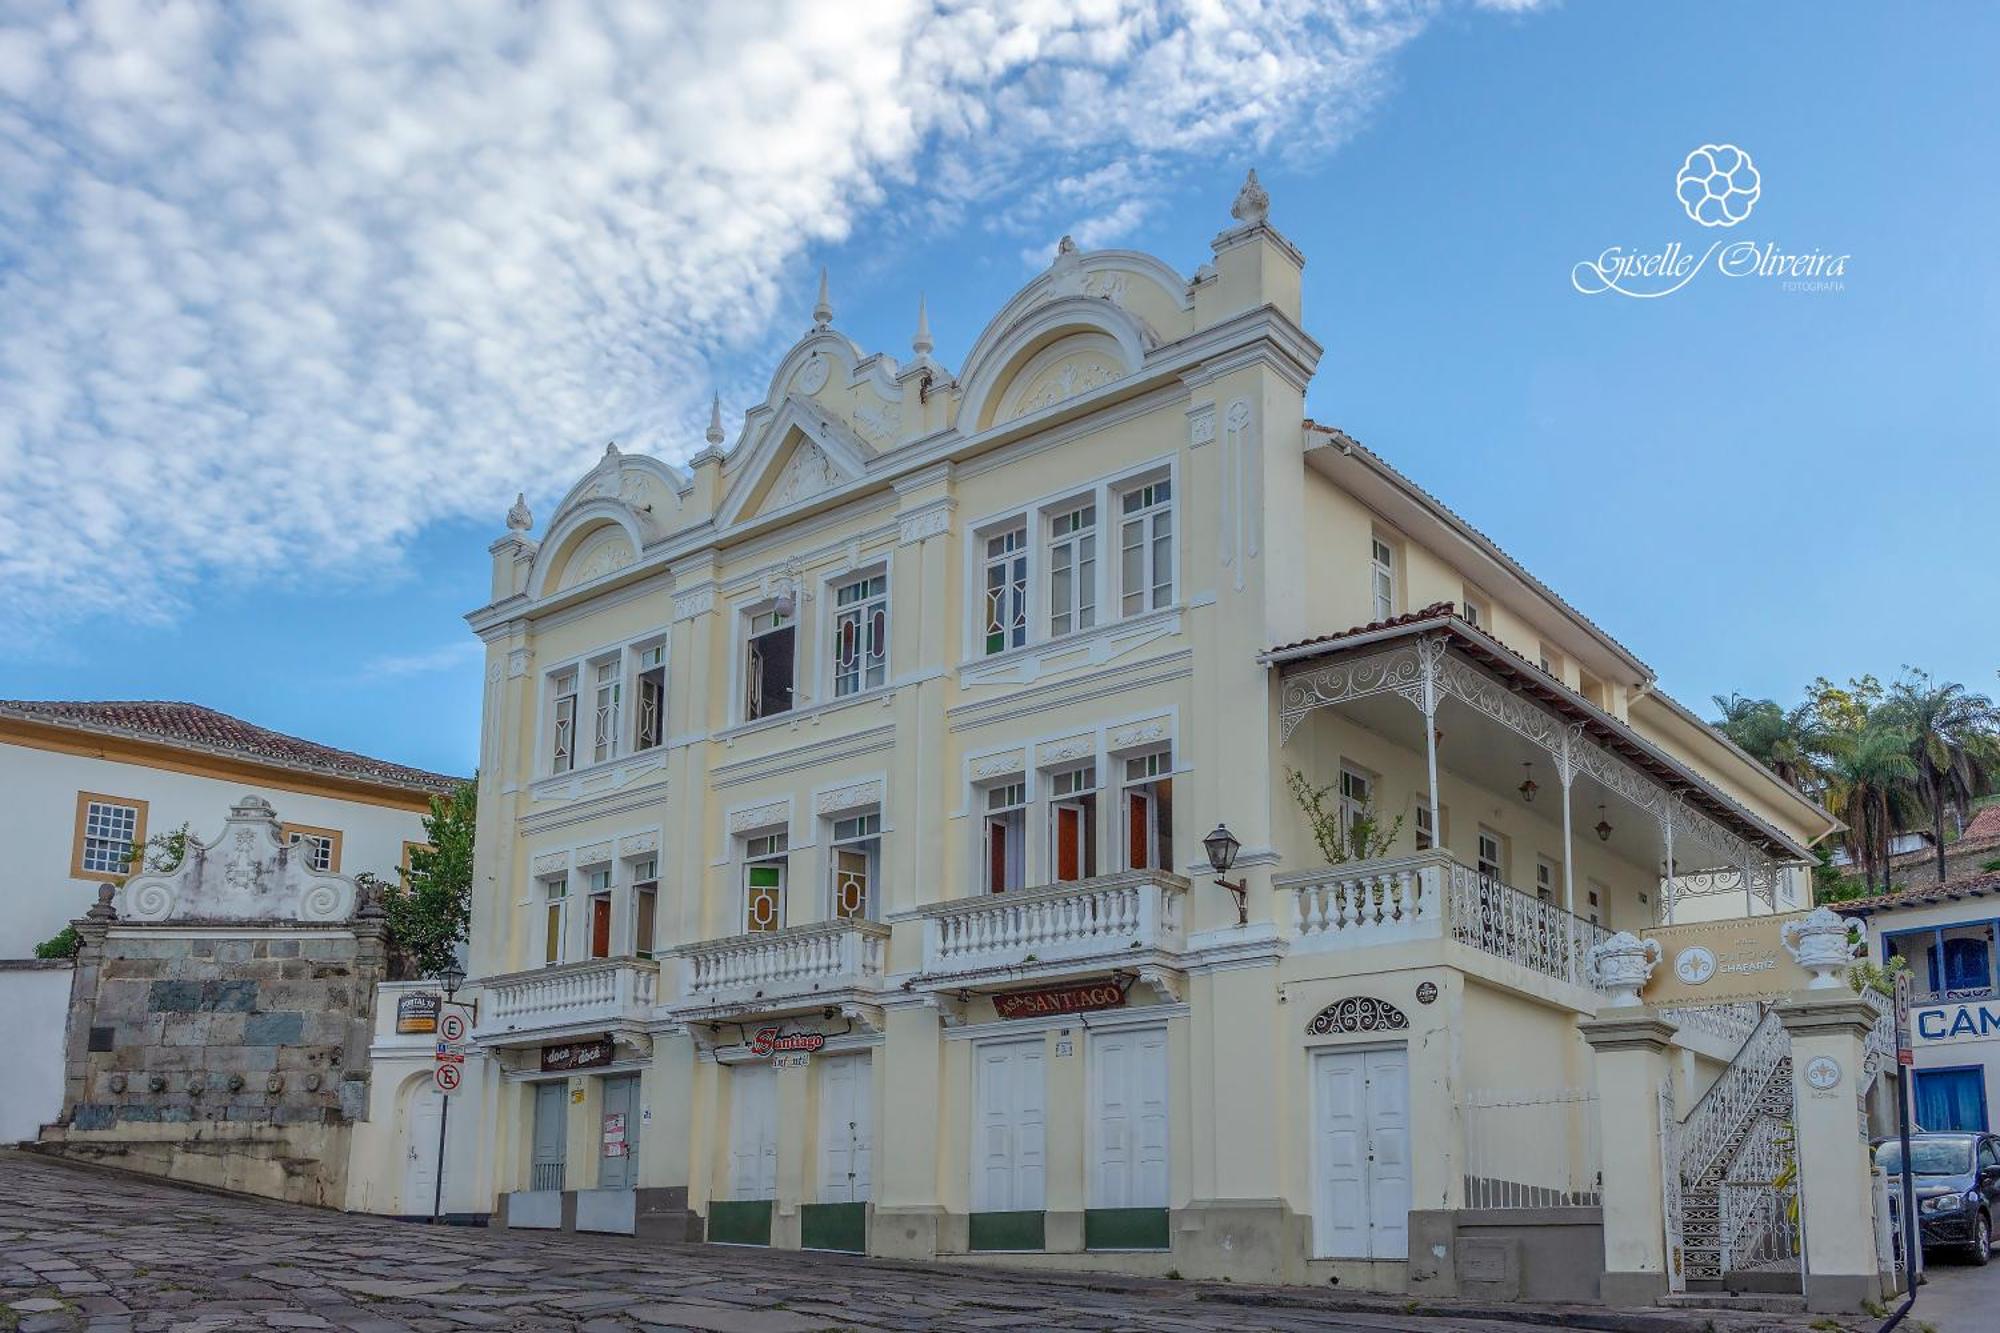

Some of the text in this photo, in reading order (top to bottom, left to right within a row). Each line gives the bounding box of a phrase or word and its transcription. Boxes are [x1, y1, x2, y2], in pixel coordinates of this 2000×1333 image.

[1024, 986, 1120, 1012] SANTIAGO
[448, 1021, 457, 1035] E
[751, 1027, 825, 1056] Santiago
